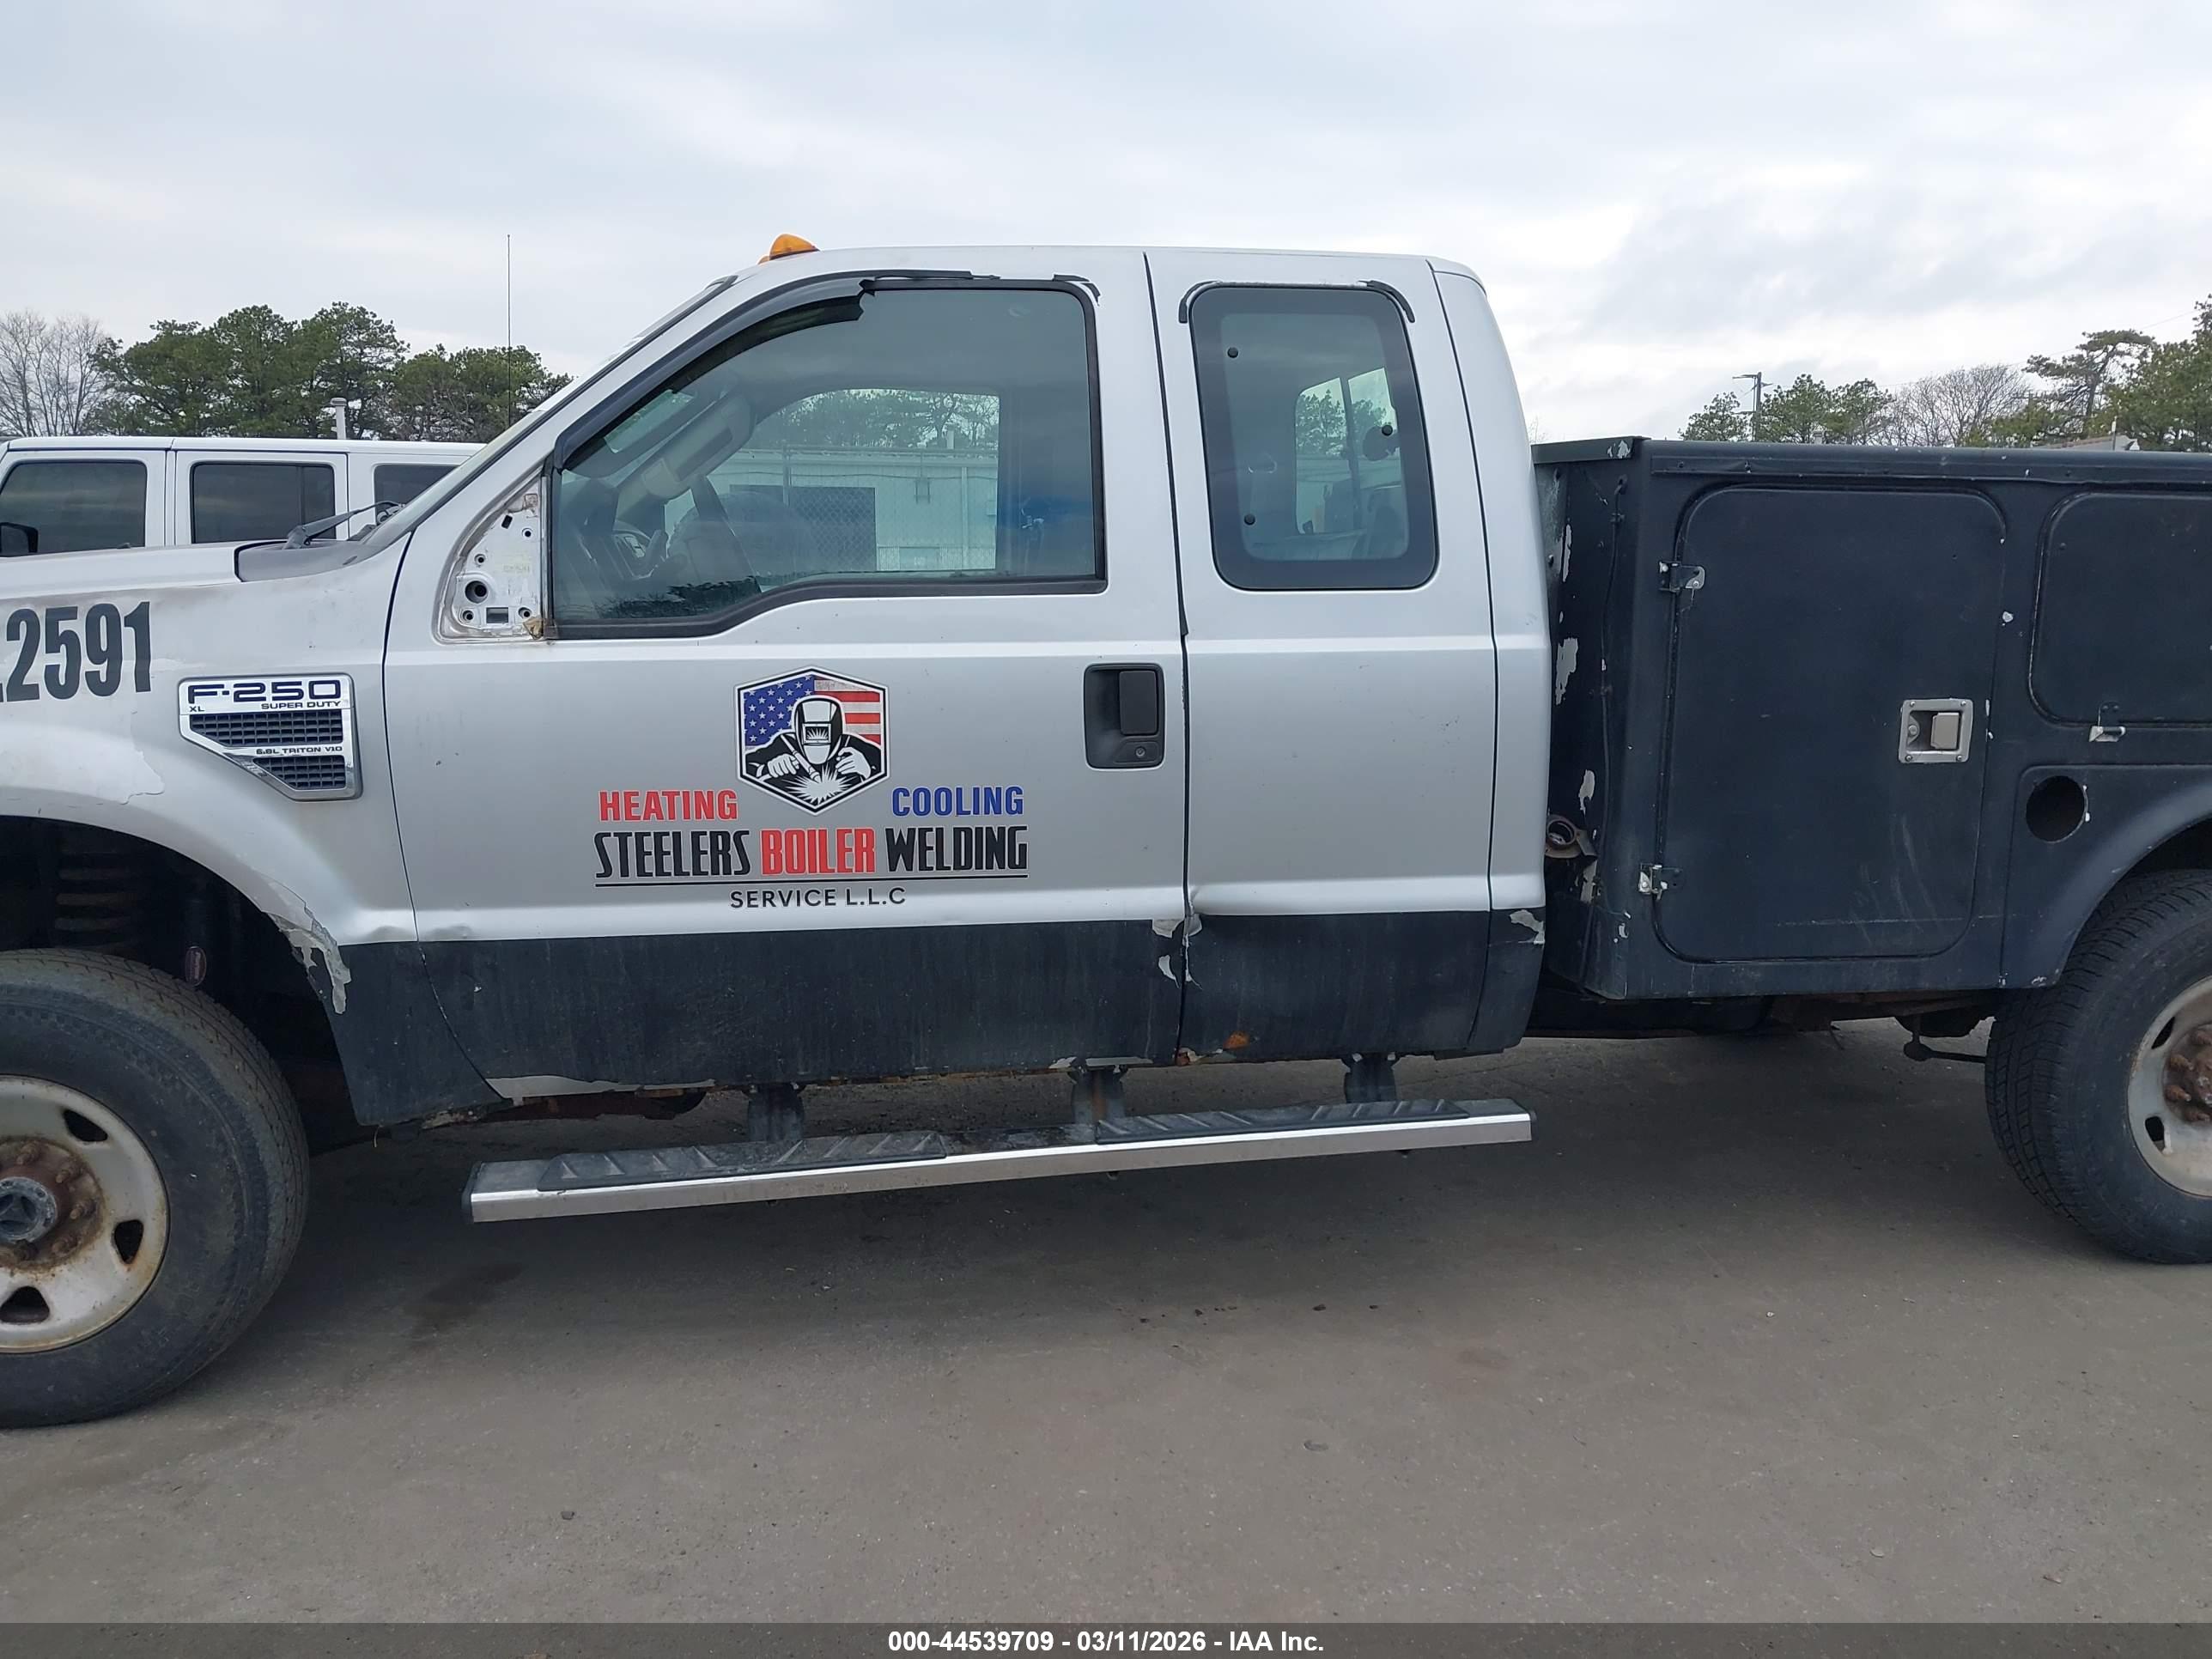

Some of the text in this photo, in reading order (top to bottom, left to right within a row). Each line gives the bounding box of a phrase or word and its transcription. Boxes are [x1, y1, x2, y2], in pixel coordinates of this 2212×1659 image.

[0, 601, 151, 703] 2591
[187, 679, 342, 704] F-250
[261, 700, 342, 710] SUPER DUTY
[599, 789, 738, 821] HEATING
[891, 786, 1024, 817] COOLING
[594, 825, 1029, 878] STEELERS BOILER WELDING
[730, 886, 907, 909] SERVICE L.L.C
